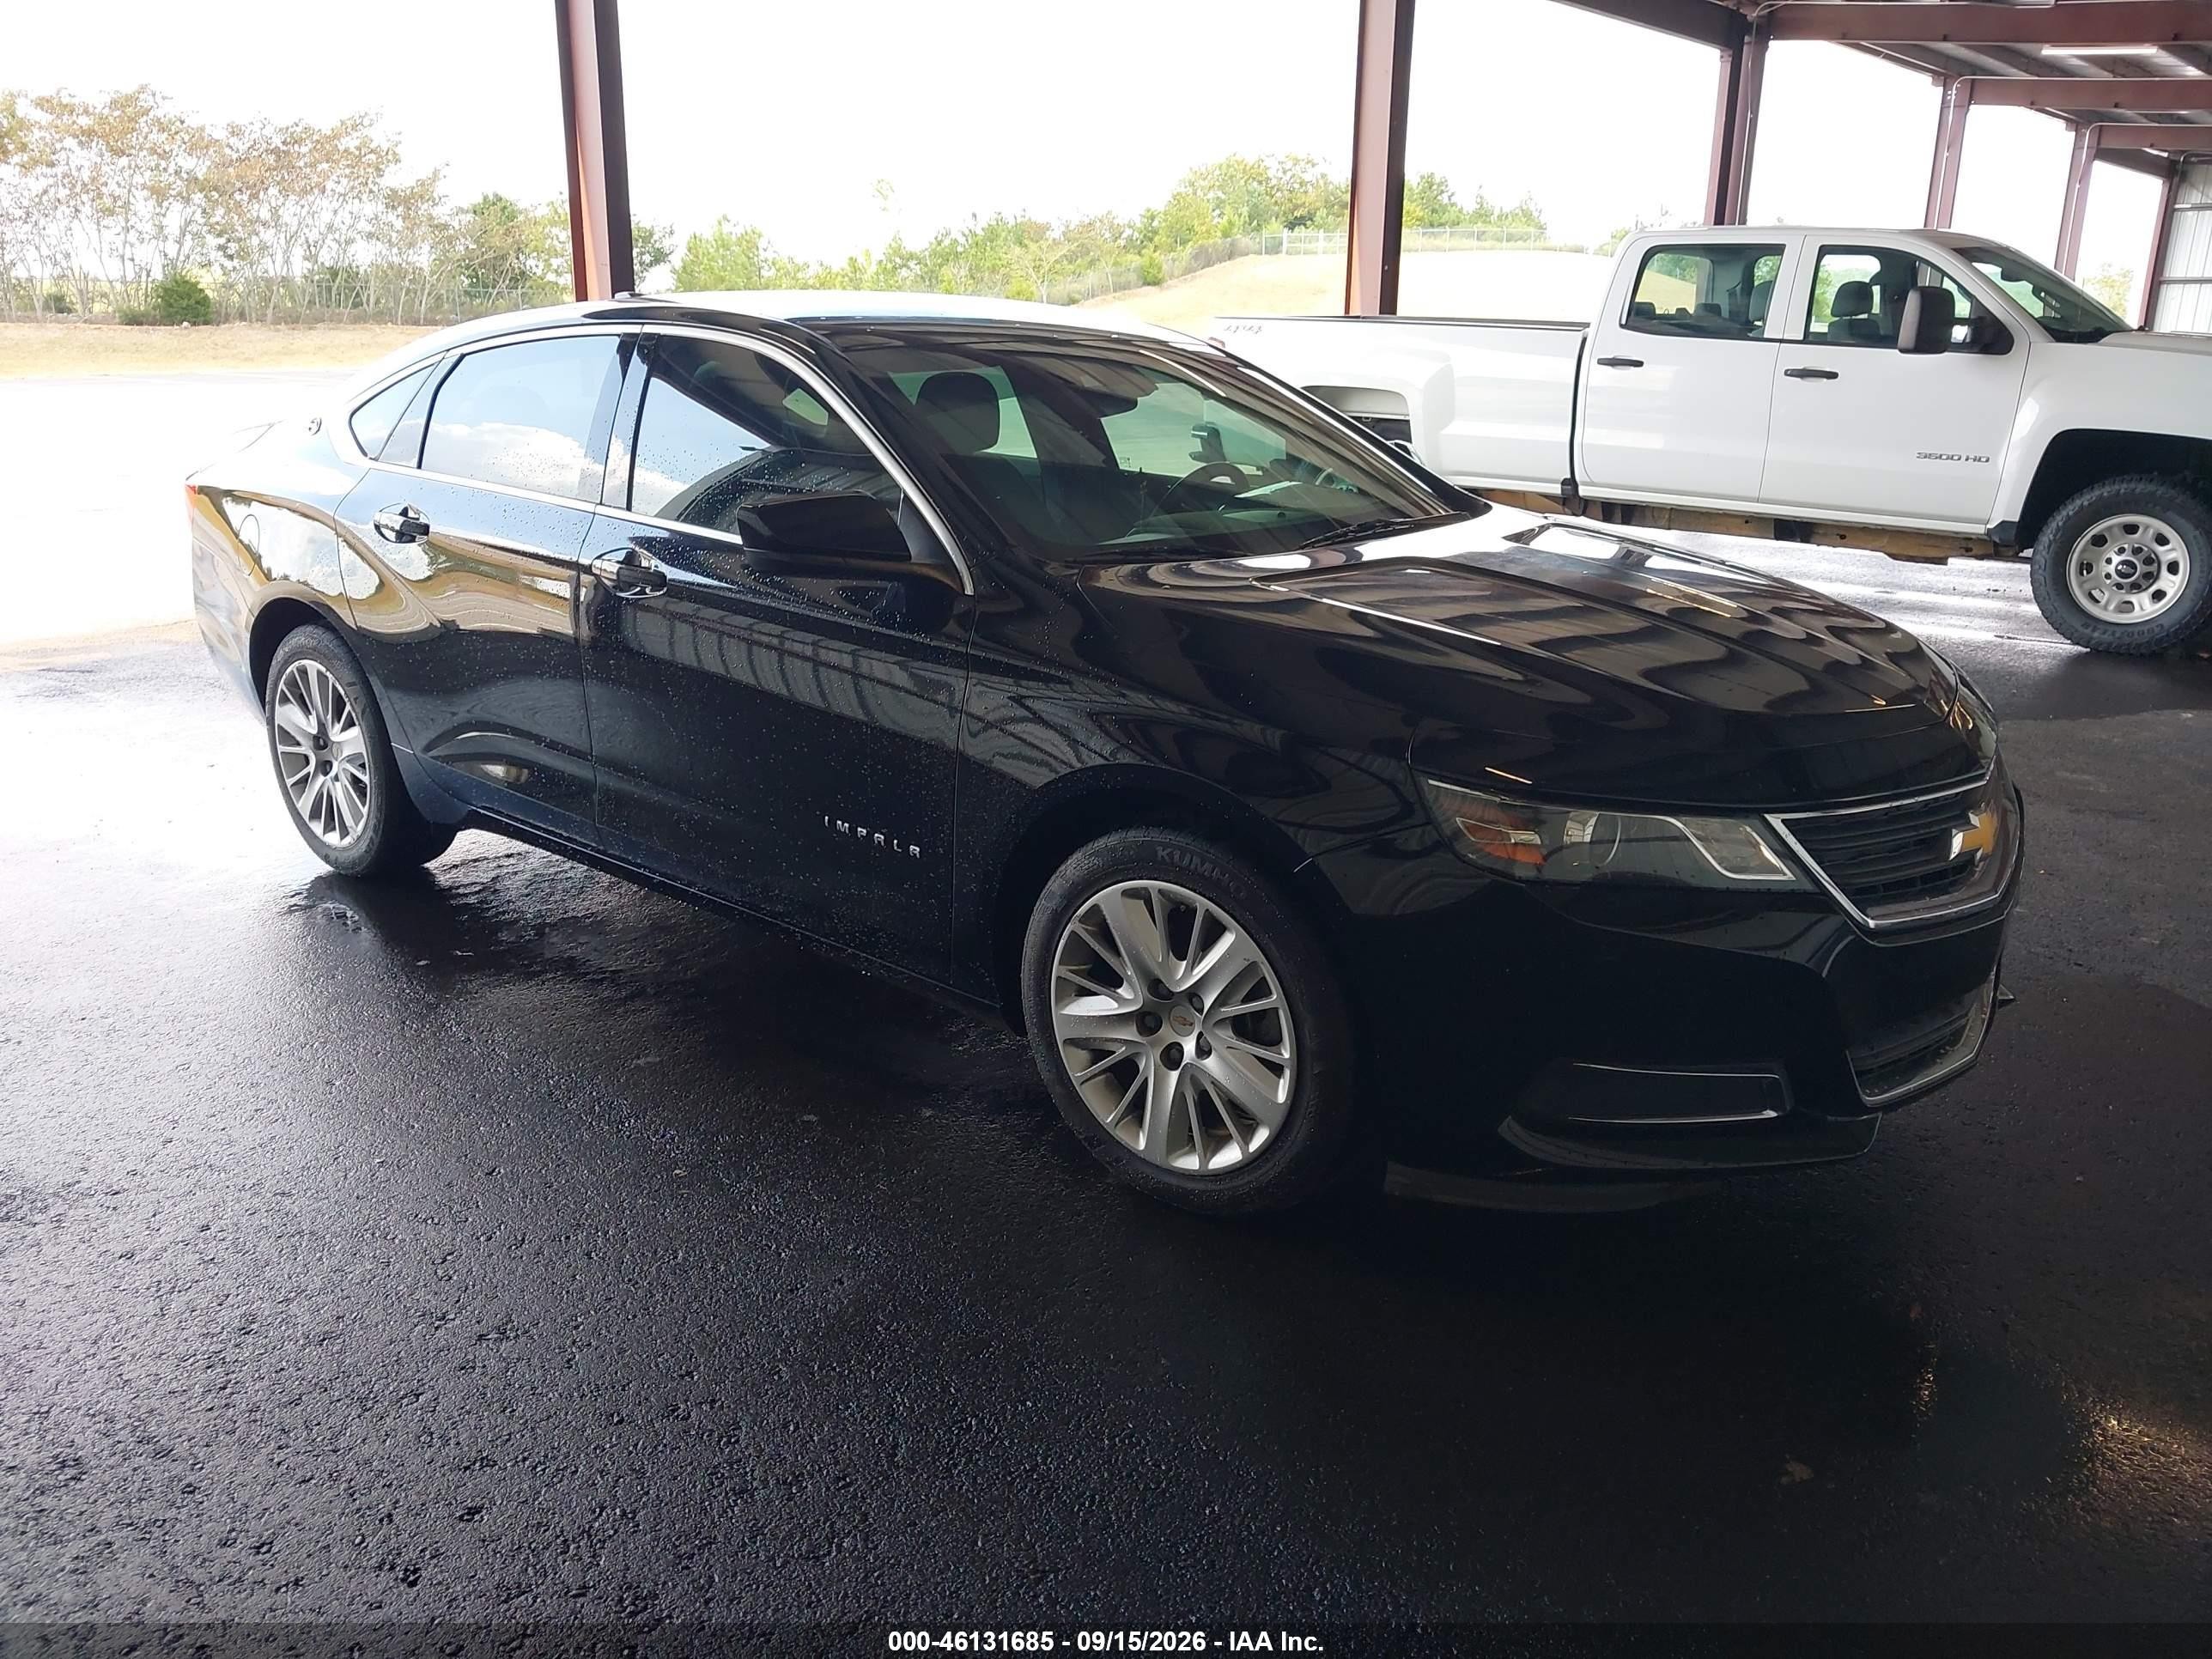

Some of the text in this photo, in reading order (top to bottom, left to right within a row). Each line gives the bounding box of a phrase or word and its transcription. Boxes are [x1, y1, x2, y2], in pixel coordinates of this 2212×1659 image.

[1916, 452, 1990, 463] 3500 HD
[824, 816, 921, 859] IMPALA
